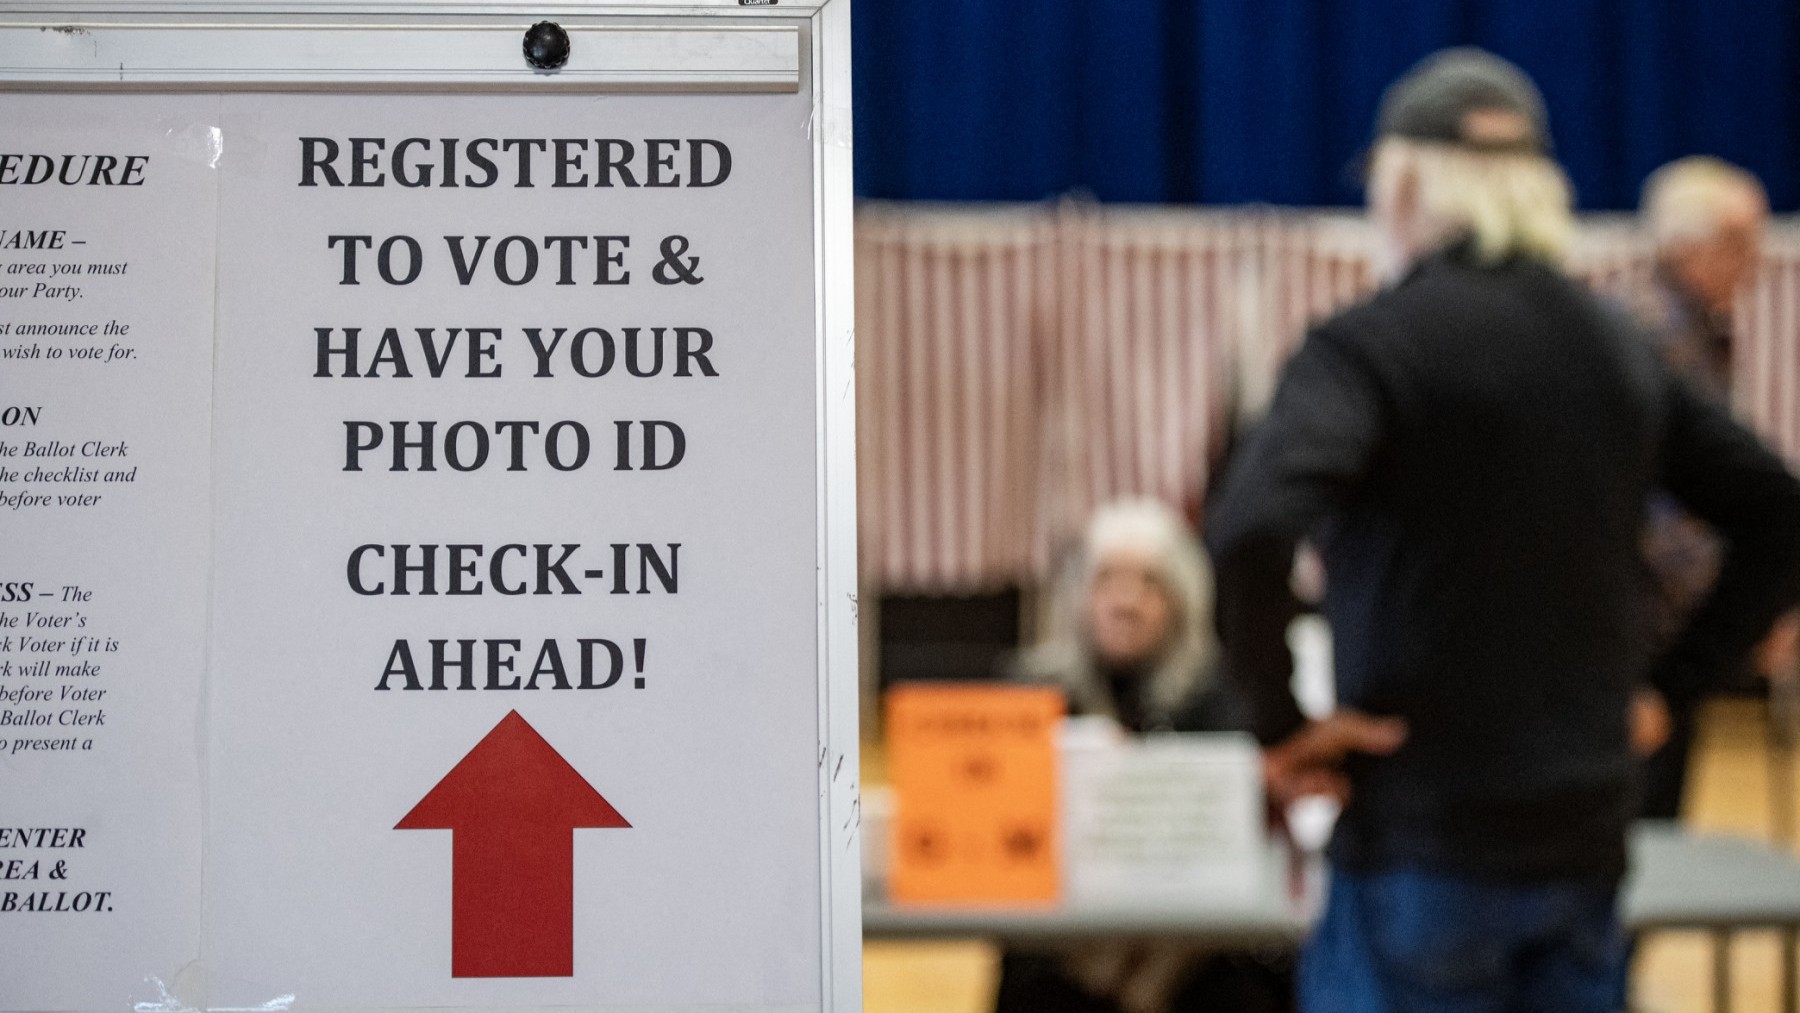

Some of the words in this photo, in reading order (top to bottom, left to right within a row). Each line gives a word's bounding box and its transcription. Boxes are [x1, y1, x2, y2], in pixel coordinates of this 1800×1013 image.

[0, 153, 150, 186] EDURE
[298, 137, 732, 188] REGISTERED
[6, 263, 46, 275] area
[49, 263, 82, 279] you
[87, 262, 128, 275] must
[328, 235, 423, 286] TO
[443, 235, 630, 286] VOTE
[652, 235, 704, 286] &
[32, 282, 83, 302] Party.
[15, 324, 99, 336] announce
[103, 319, 130, 336] the
[2, 343, 41, 359] wish
[46, 346, 63, 359] to
[69, 346, 104, 359] vote
[103, 343, 137, 363] for.
[313, 327, 502, 378] HAVE
[521, 327, 720, 378] YOUR
[1, 406, 43, 427] ON
[23, 441, 76, 457] Ballot
[81, 441, 128, 457] Clerk
[342, 420, 590, 472] PHOTO
[613, 420, 686, 471] ID
[23, 466, 99, 483] checklist
[103, 466, 138, 483] and
[0, 490, 52, 511] before
[57, 494, 102, 507] voter
[346, 543, 682, 596] CHECK-IN
[0, 582, 34, 603] SS
[62, 585, 93, 602] The
[19, 636, 66, 653] Voter
[70, 636, 87, 656] if
[87, 637, 100, 652] it
[105, 637, 119, 652] is
[19, 660, 51, 677] will
[55, 660, 101, 677] make
[374, 638, 647, 691] AHEAD!
[0, 685, 53, 706] before
[60, 685, 107, 701] Voter
[0, 709, 53, 726] Ballot
[58, 709, 105, 726] Clerk
[11, 737, 77, 755] present
[81, 739, 93, 751] a
[0, 827, 87, 848] ENTER
[0, 859, 39, 880] EA
[48, 859, 68, 881] &
[0, 891, 113, 912] BALLOT.
